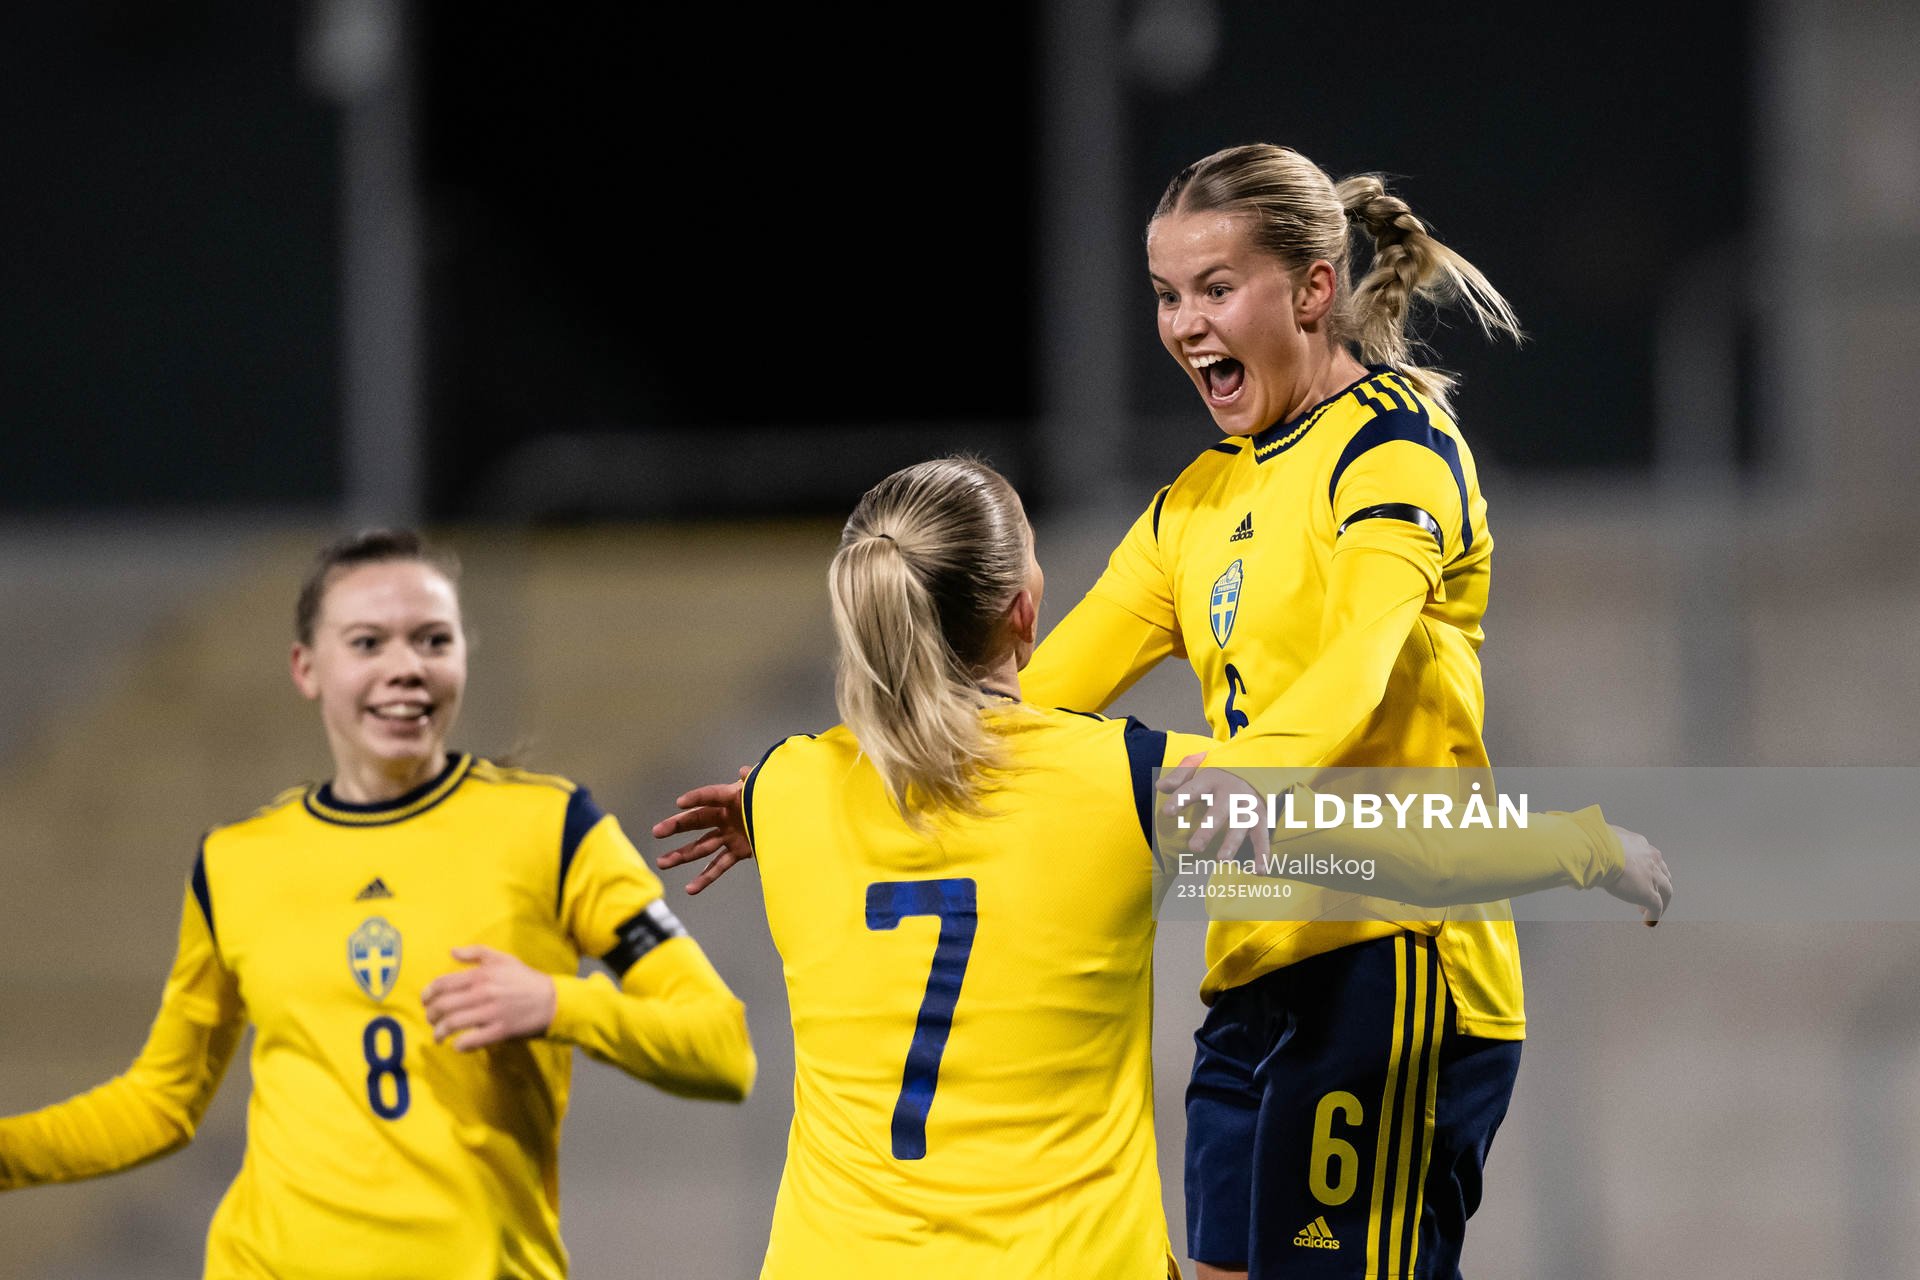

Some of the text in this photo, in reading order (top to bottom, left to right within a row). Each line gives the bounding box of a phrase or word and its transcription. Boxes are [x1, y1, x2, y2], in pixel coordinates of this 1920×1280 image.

[363, 1015, 410, 1120] 8
[865, 878, 978, 1160] 7
[1309, 1090, 1364, 1206] 6
[1293, 1235, 1340, 1250] adidas
